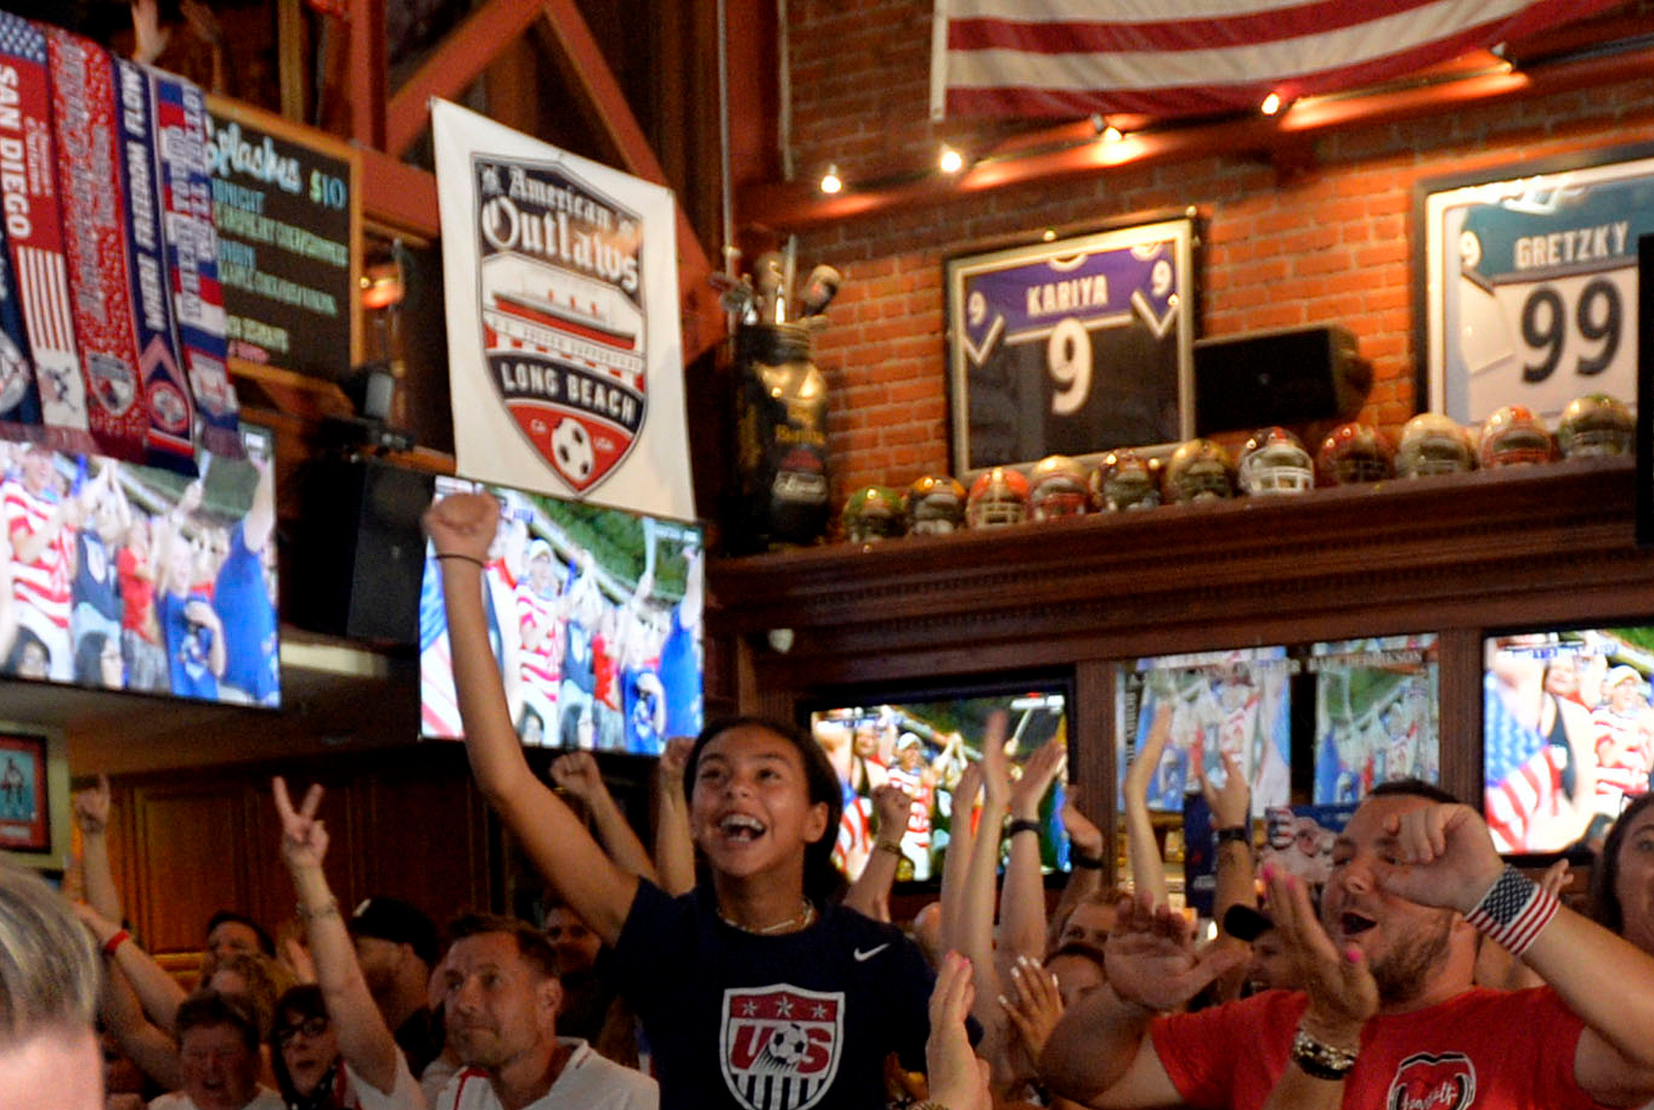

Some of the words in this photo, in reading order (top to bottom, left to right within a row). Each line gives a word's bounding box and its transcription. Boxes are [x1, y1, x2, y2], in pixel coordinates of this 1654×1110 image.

[309, 168, 347, 212] $10
[508, 164, 612, 232] American
[481, 195, 639, 294] Outlaws
[1514, 221, 1630, 270] GRETZKY
[1026, 273, 1109, 318] KARIYA
[1151, 259, 1172, 297] 9
[968, 290, 988, 326] 9
[1521, 275, 1624, 384] 99
[1049, 317, 1093, 416] 9
[500, 362, 560, 398] LONG
[566, 373, 638, 426] BEACH
[731, 1024, 833, 1075] US
